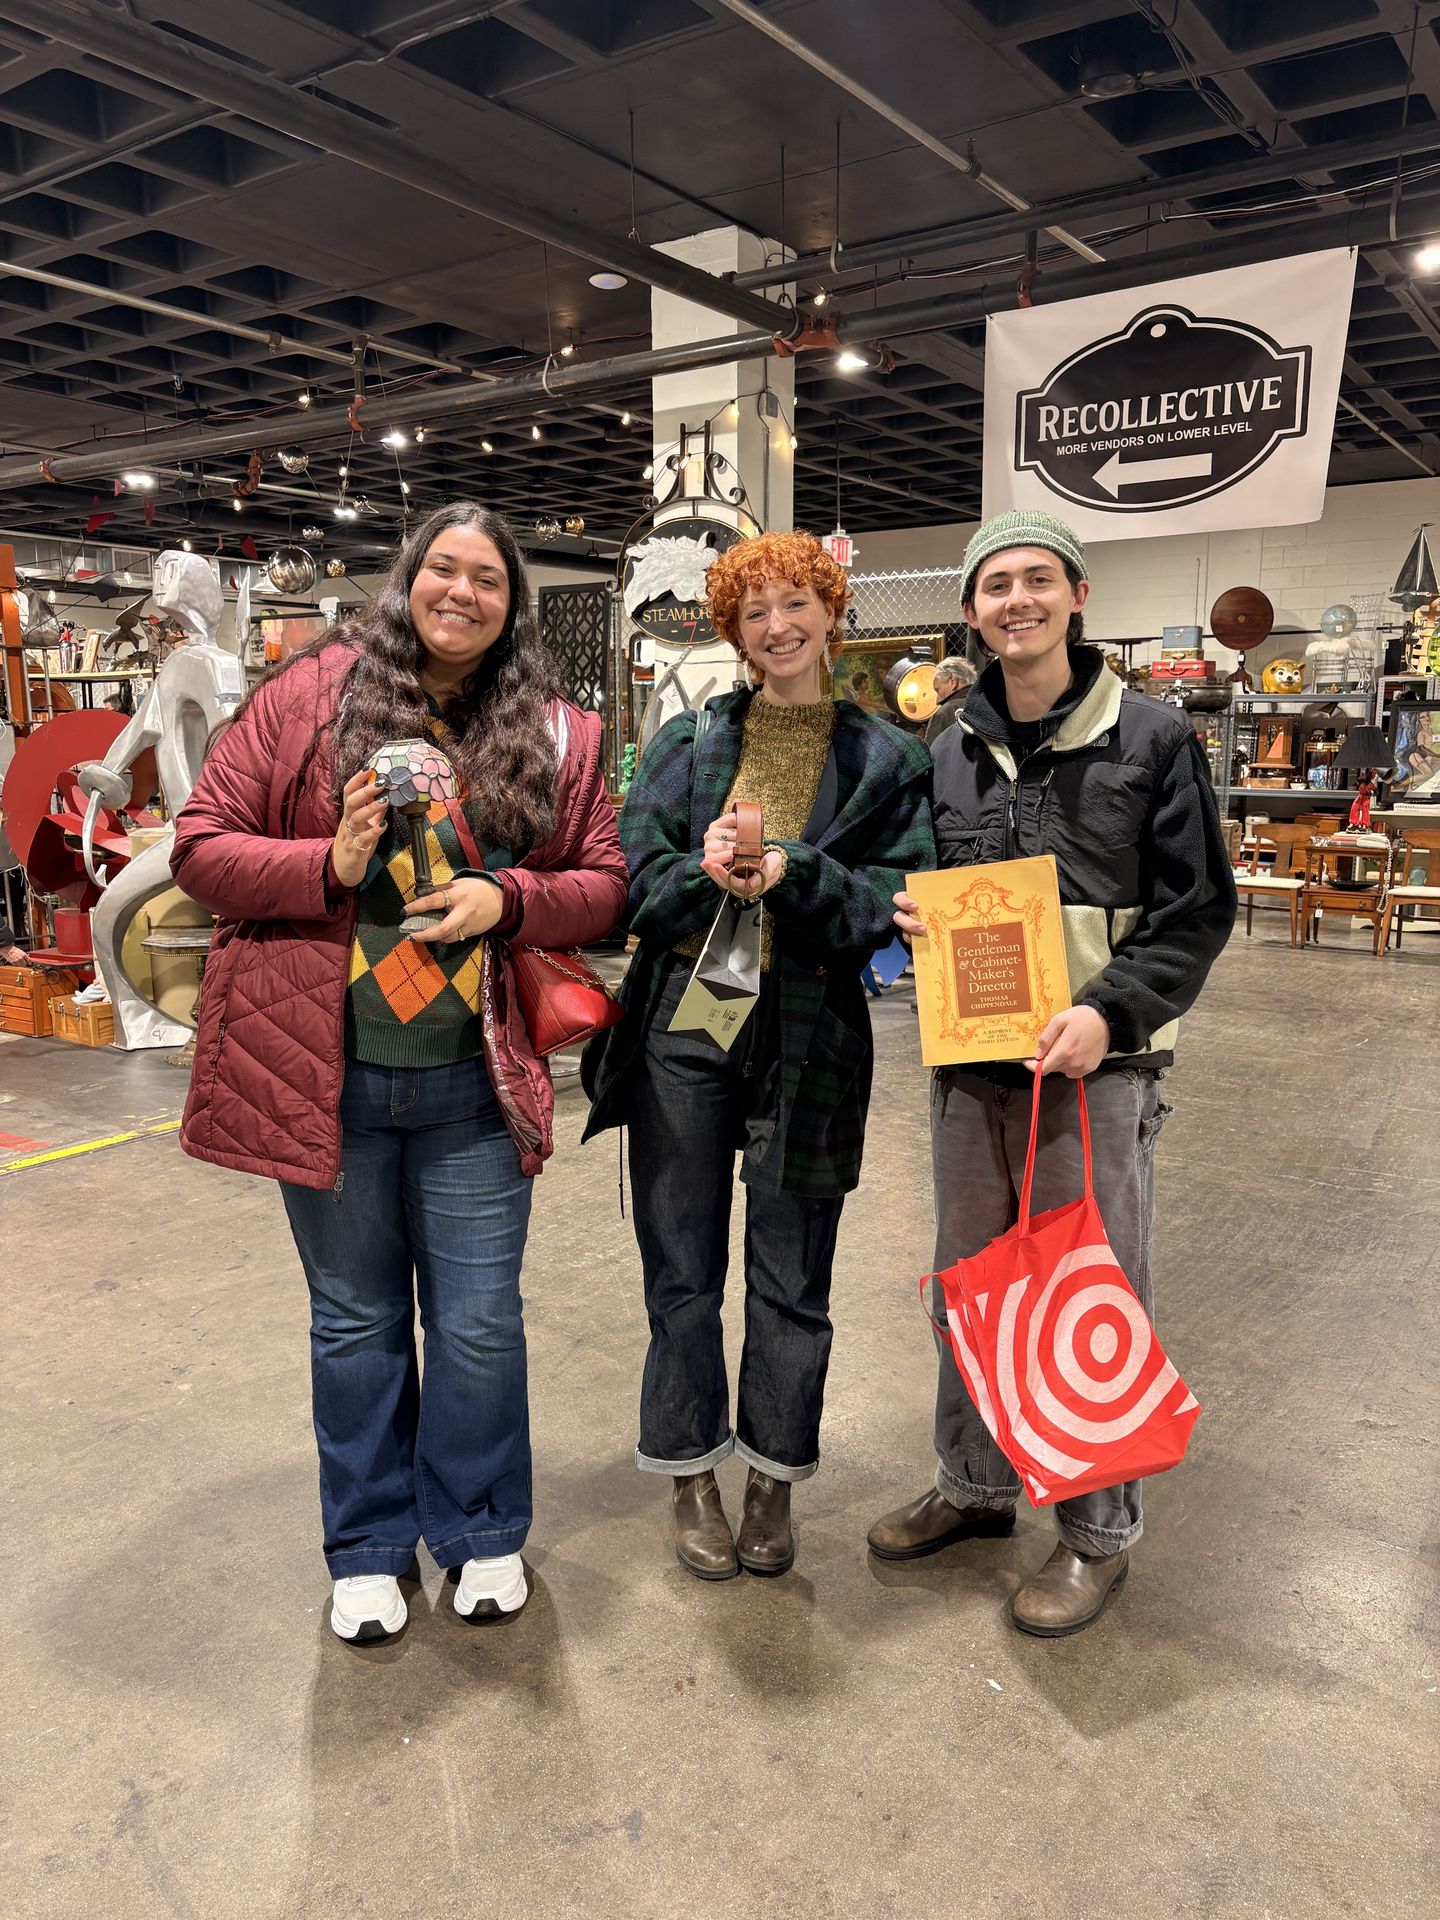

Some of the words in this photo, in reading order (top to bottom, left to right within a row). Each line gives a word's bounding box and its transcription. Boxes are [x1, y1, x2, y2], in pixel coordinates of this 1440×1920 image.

[1037, 375, 1283, 442] RECOLLECTIVE
[1056, 442, 1088, 456] MORE
[1090, 435, 1145, 452] VENDORS
[1147, 433, 1164, 445] ON
[1167, 426, 1211, 442] LOWER
[1213, 421, 1253, 436] LEVEL
[831, 538, 849, 563] EXIT
[973, 932, 1001, 944] The
[957, 944, 1021, 958] Gentleman
[959, 960, 970, 970] &
[968, 967, 1015, 982] Maker's
[968, 981, 1017, 994] Director
[970, 1000, 1019, 1010] CHIPPENDALE
[978, 994, 1009, 1003] THOMAS
